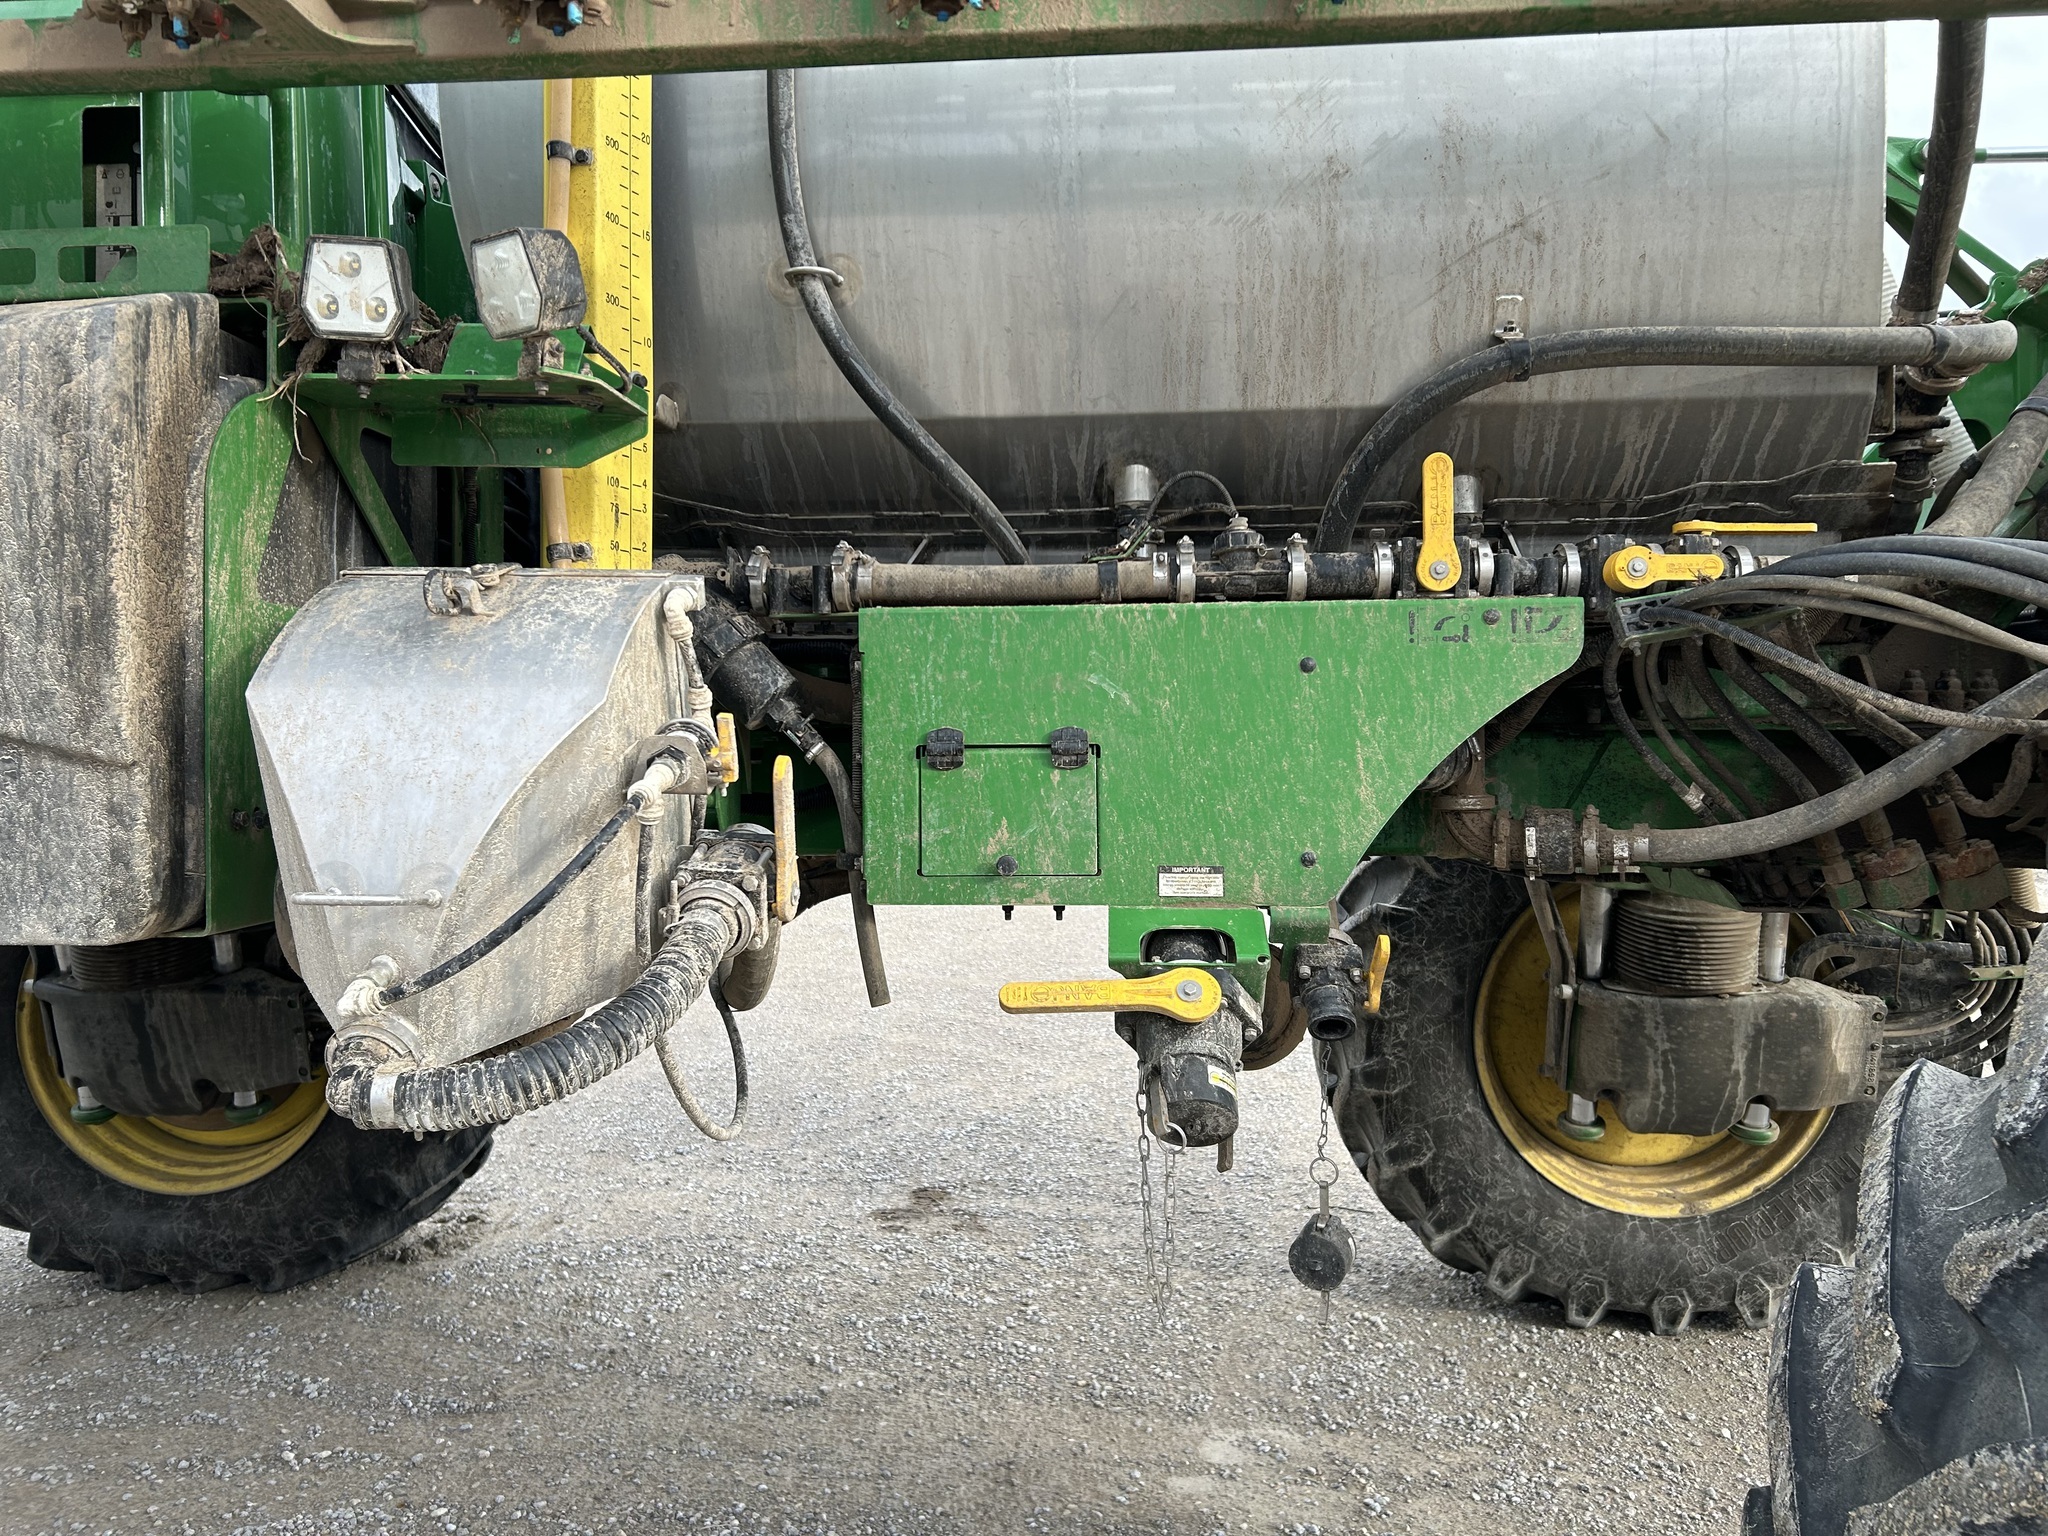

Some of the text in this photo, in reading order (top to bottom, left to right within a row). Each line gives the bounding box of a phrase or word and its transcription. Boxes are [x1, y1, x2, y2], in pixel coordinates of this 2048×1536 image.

[605, 136, 620, 151] 500
[641, 132, 651, 145] 20
[605, 211, 620, 225] 400
[642, 230, 651, 242] 15
[605, 292, 620, 307] 300
[642, 337, 652, 348] 10
[642, 443, 648, 453] 5
[606, 477, 620, 488] 100
[642, 478, 648, 489] 4
[642, 503, 647, 513] 3
[610, 542, 620, 552] 50
[641, 542, 647, 552] 2
[1686, 1142, 1867, 1277] RELLEBORG
